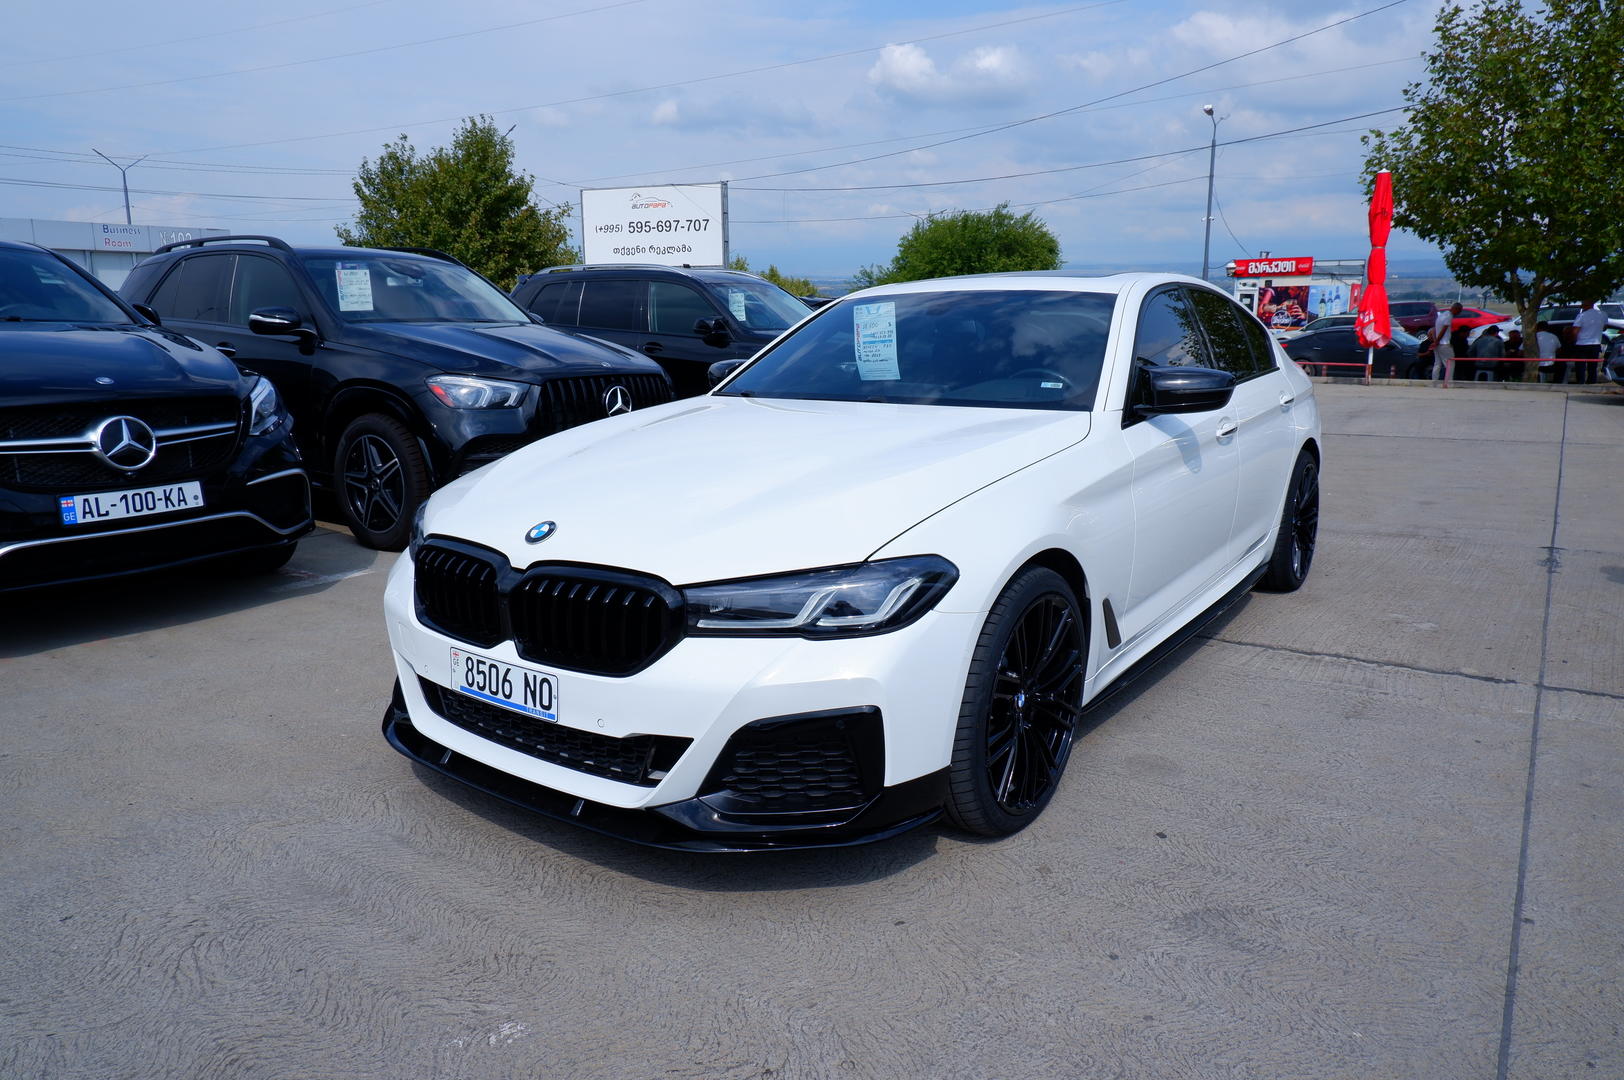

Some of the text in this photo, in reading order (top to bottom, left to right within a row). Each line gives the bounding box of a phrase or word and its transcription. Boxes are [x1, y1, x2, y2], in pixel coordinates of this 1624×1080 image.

[595, 219, 710, 233] (+995) 595-697-707
[104, 238, 132, 247] Room
[613, 244, 692, 256] თქვენი რეკლამა
[82, 486, 188, 519] AL-100-KA
[63, 511, 76, 521] GE
[465, 656, 553, 711] 8506 NO
